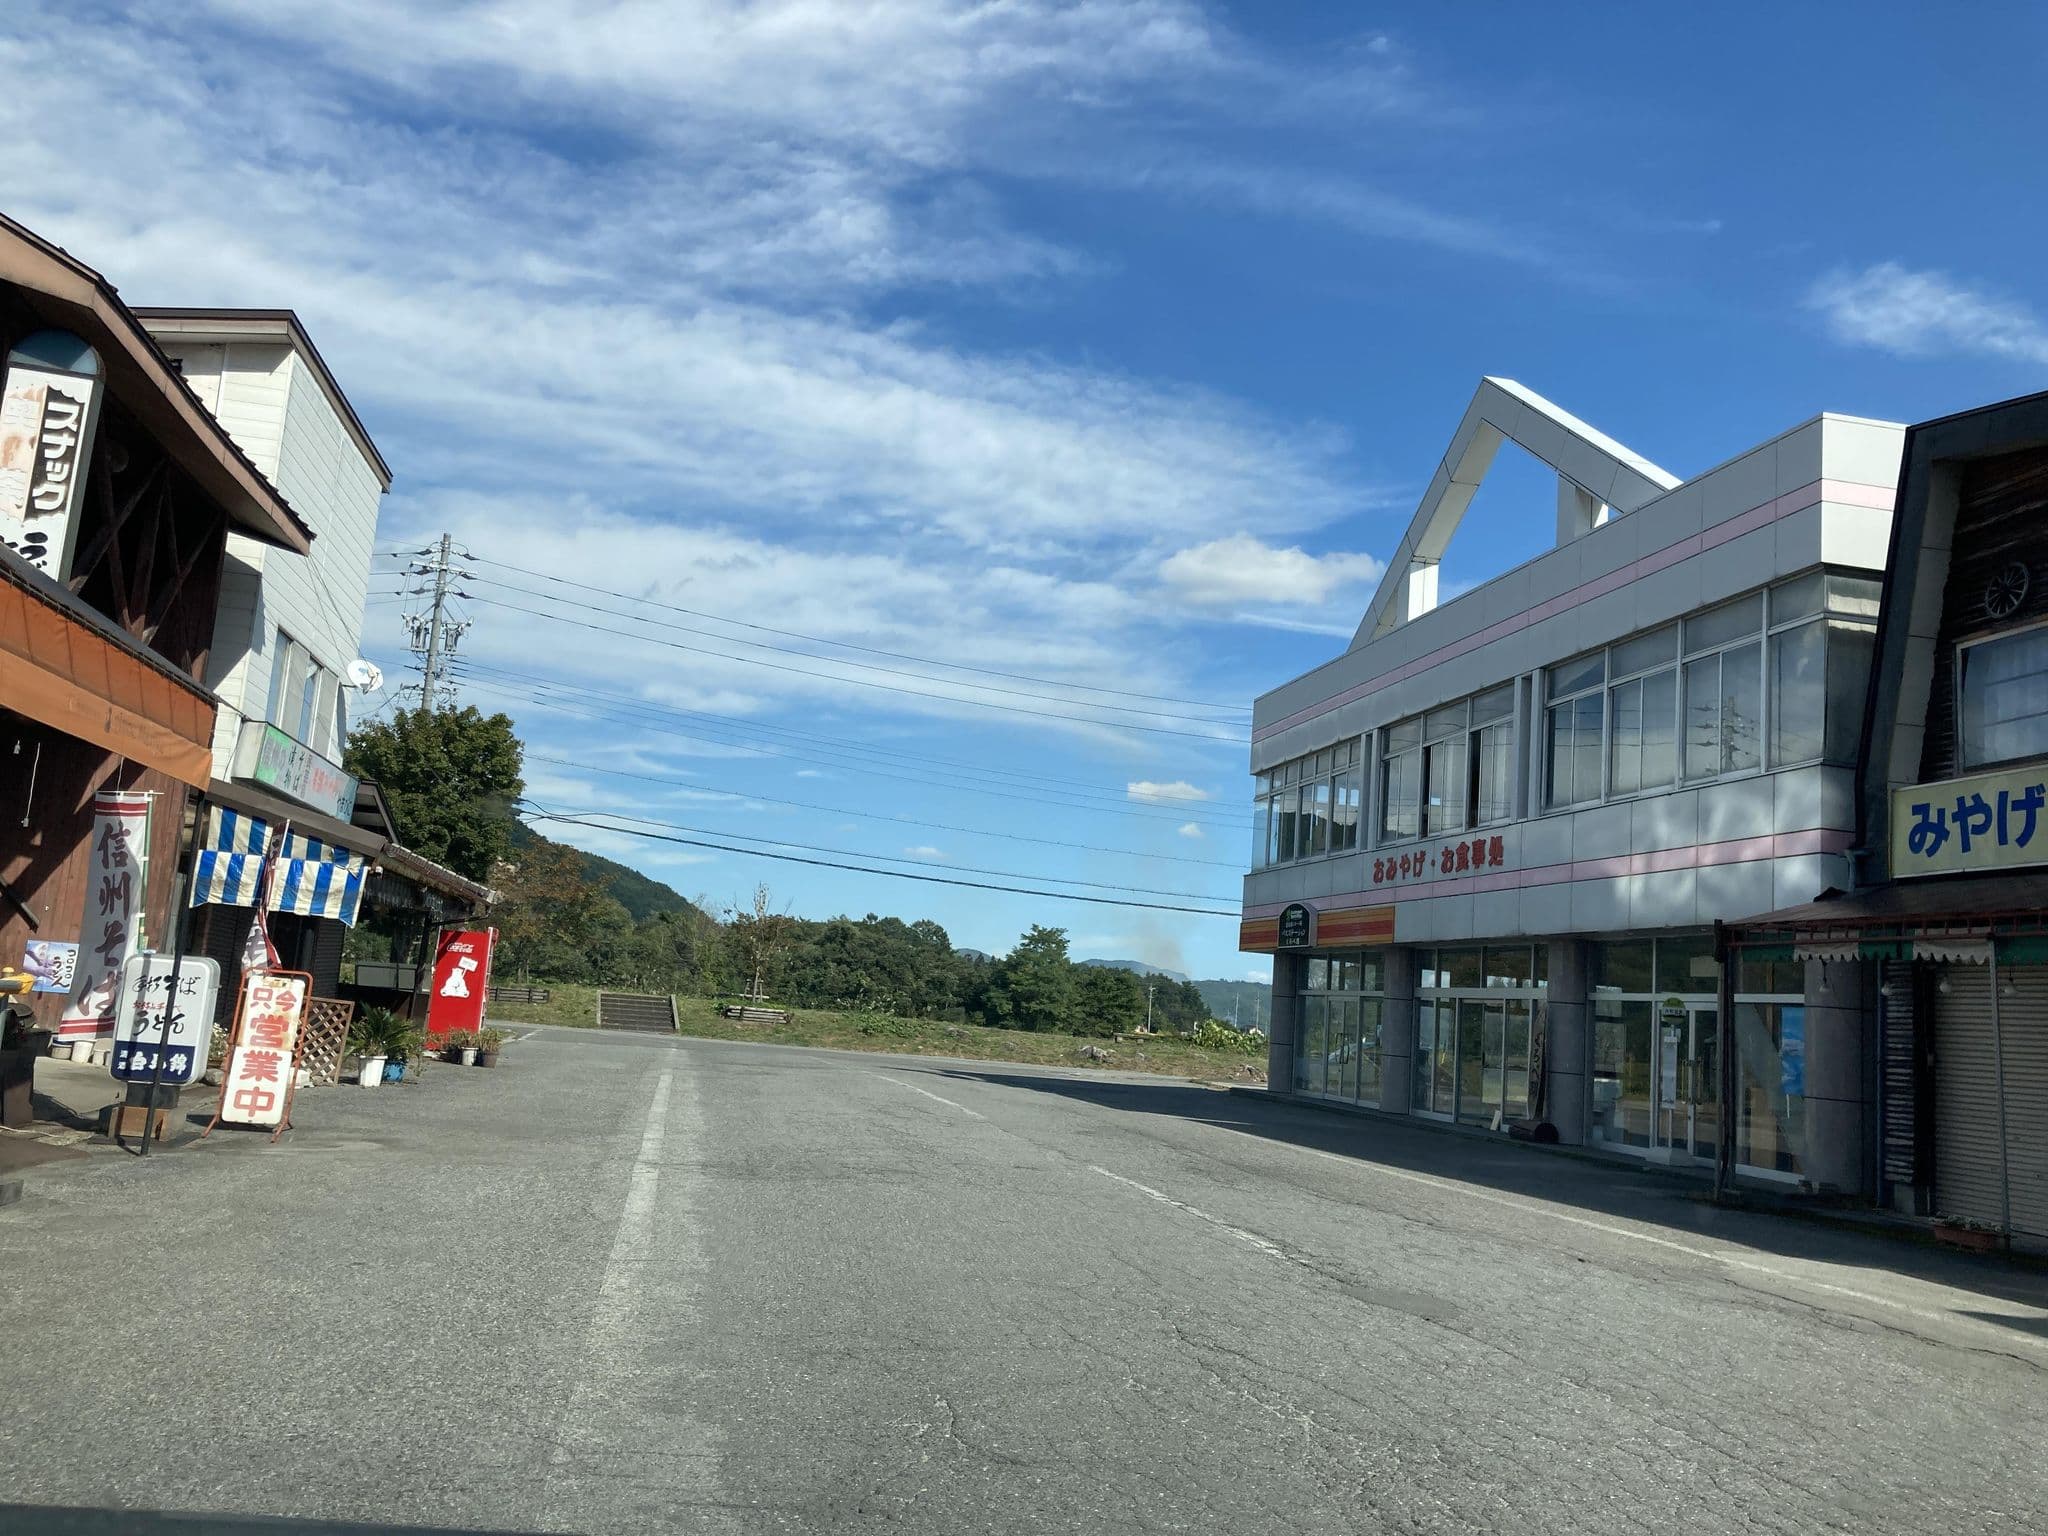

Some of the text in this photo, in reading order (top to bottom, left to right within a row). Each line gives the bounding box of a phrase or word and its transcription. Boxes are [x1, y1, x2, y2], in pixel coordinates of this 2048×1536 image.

[32, 401, 80, 511] スナック
[1908, 784, 2046, 857] みやげ
[77, 819, 131, 1017] 信州そば
[51, 956, 70, 988] うどん
[250, 987, 297, 1012] 只今
[233, 1013, 290, 1118] 営業中
